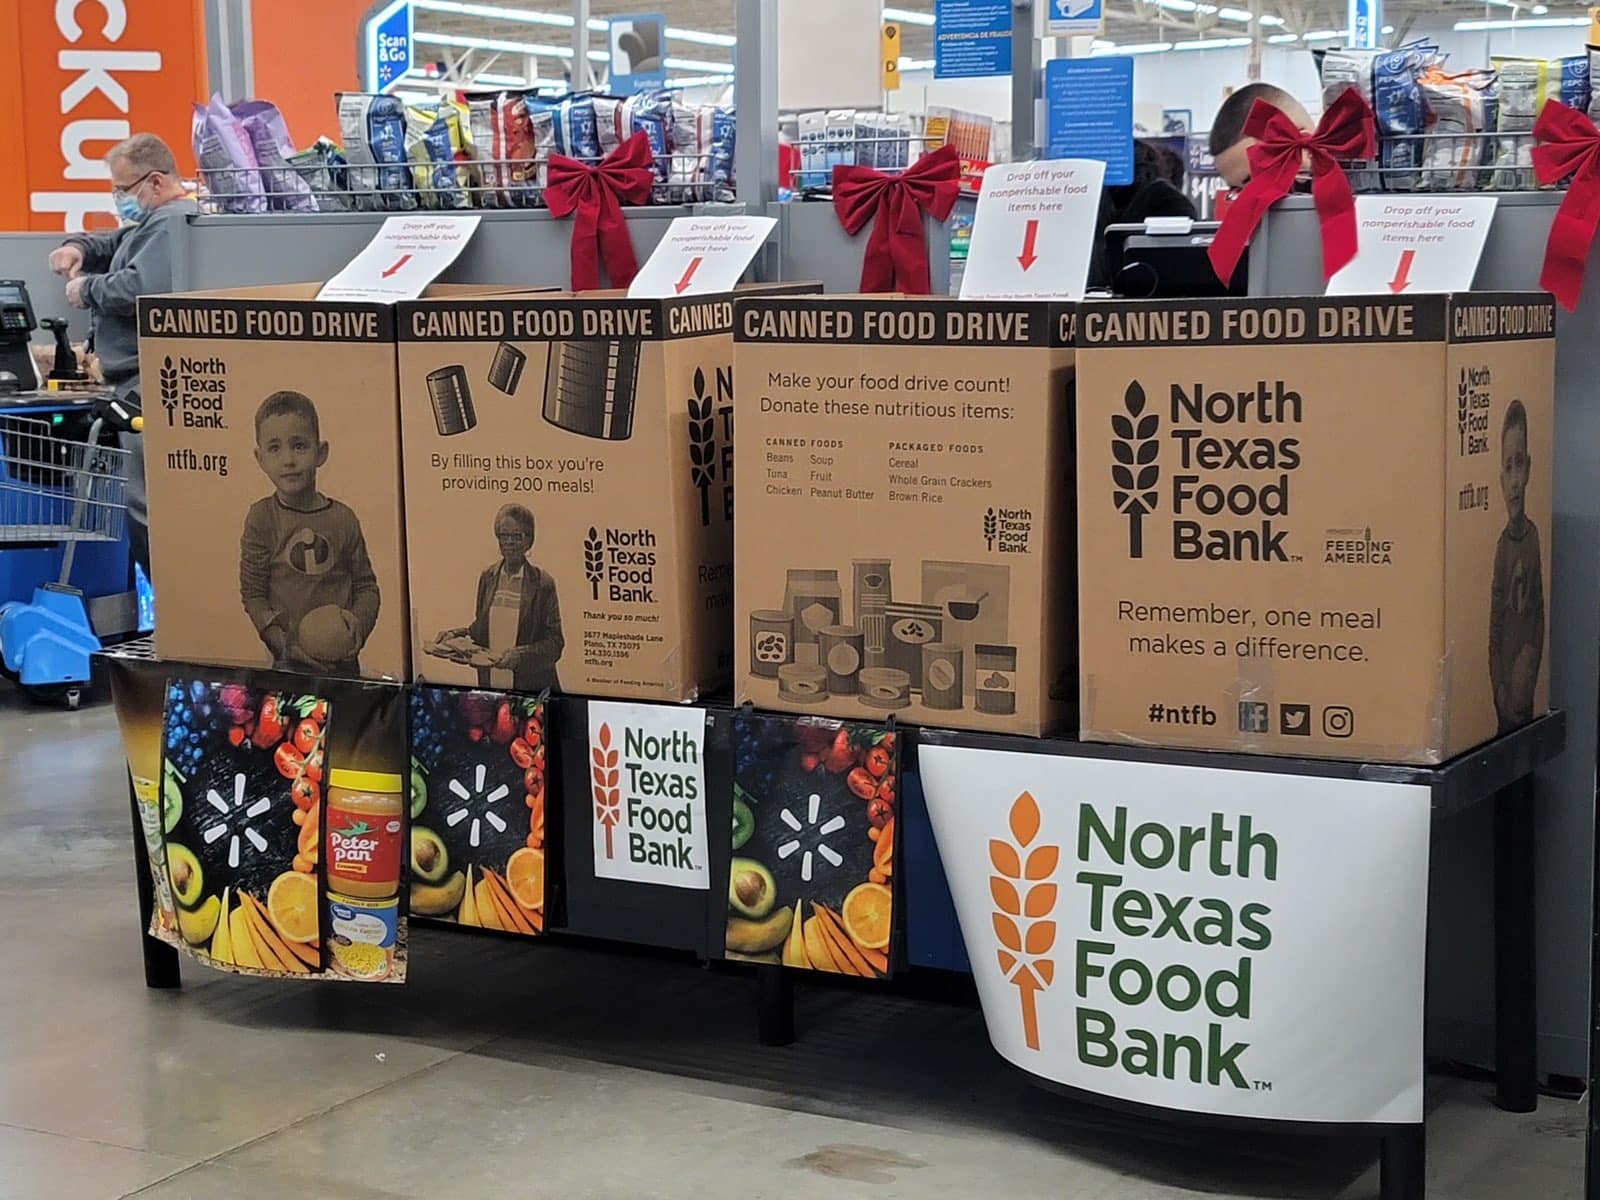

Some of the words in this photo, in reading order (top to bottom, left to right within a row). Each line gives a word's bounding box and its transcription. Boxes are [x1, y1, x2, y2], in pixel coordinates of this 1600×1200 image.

[379, 33, 407, 48] Scan
[379, 48, 407, 62] &Go
[1007, 172, 1031, 182] Drop
[1034, 170, 1049, 180] off
[1051, 170, 1074, 182] your
[990, 186, 1061, 198] nonperishable
[1064, 184, 1088, 194] food
[1008, 202, 1037, 212] items
[1039, 202, 1063, 211] here
[1384, 206, 1413, 215] Drop
[1416, 206, 1435, 215] off
[1435, 207, 1462, 216] your
[1362, 220, 1445, 229] nonperishable
[1447, 220, 1475, 228] food
[1382, 234, 1415, 242] items
[1418, 234, 1445, 242] here
[149, 308, 238, 334] CANNED
[246, 310, 304, 336] FOOD
[312, 311, 378, 338] DRIVE
[412, 310, 504, 337] CANNED
[513, 310, 574, 336] FOOD
[583, 308, 652, 336] DRIVE
[669, 302, 733, 334] CANNED
[743, 310, 853, 339] CANNED
[863, 311, 936, 340] FOOD
[946, 312, 1029, 341] DRIVE
[1085, 311, 1211, 342] CANNED
[1222, 308, 1306, 340] FOOD
[1318, 305, 1414, 337] DRIVE
[1455, 306, 1497, 338] CANNED
[1500, 306, 1525, 335] FOOD
[1527, 305, 1553, 333] DRIVE
[180, 357, 226, 375] North
[181, 376, 226, 393] Texas
[768, 372, 812, 389] Make
[816, 374, 855, 391] your
[860, 373, 899, 391] food
[904, 375, 948, 391] drive
[954, 376, 1011, 393] count!
[1468, 365, 1491, 386] North
[183, 394, 222, 410] Food
[760, 398, 819, 414] Donate
[824, 399, 870, 415] these
[874, 401, 956, 418] nutritious
[962, 402, 1015, 419] items:
[1170, 381, 1302, 424] North
[1469, 390, 1490, 409] Texas
[184, 412, 224, 429] Bank
[1468, 410, 1488, 432] Food
[765, 438, 807, 448] CANNED
[810, 439, 844, 449] FOODS
[889, 442, 944, 452] PACKAGED
[948, 444, 984, 454] FOODS
[1171, 429, 1301, 470] Texas
[1468, 435, 1488, 455] Bank
[168, 449, 228, 476] ntfb.org
[431, 454, 449, 470] By
[454, 453, 491, 471] filling
[495, 454, 522, 470] this
[525, 455, 554, 471] box
[558, 456, 604, 473] you're
[766, 452, 794, 463] Beans
[809, 454, 834, 466] Soup
[889, 457, 919, 469] Cereal
[766, 468, 788, 479] Tuna
[810, 471, 832, 482] Fruit
[889, 474, 918, 486] Whole
[920, 475, 947, 487] Grain
[950, 477, 992, 489] Crackers
[442, 475, 509, 493] providing
[513, 477, 543, 491] 200
[547, 478, 595, 493] meals!
[766, 485, 802, 496] Chicken
[810, 487, 843, 499] Peanut
[845, 489, 874, 500] Butter
[889, 490, 918, 502] Brown
[921, 492, 943, 504] Rice
[1173, 474, 1288, 516] Food
[999, 509, 1032, 520] North
[999, 519, 1031, 531] Texas
[606, 528, 656, 546] North
[999, 531, 1028, 542] Food
[1173, 520, 1289, 562] Bank
[999, 542, 1027, 553] Bank
[1326, 540, 1391, 552] FEEDING
[607, 548, 656, 565] Texas
[1325, 553, 1392, 565] AMERICA
[608, 566, 653, 584] Food
[609, 585, 654, 603] Bank
[583, 611, 605, 619] Thank
[1118, 600, 1257, 628] Remember,
[1264, 609, 1312, 627] one
[1320, 607, 1382, 630] meal
[602, 632, 644, 641] Mapleshade
[1129, 633, 1205, 656] makes
[1213, 640, 1227, 657] a
[1235, 636, 1369, 662] difference.
[1148, 703, 1217, 726] #ntfb
[625, 727, 697, 764] North
[625, 763, 697, 800] Texas
[627, 798, 692, 835] Food
[330, 832, 379, 851] Peter
[1077, 803, 1278, 881] North
[629, 832, 693, 870] Bank
[1076, 871, 1272, 950] Texas
[1076, 939, 1252, 1020] Food
[1076, 1005, 1250, 1089] Bank
